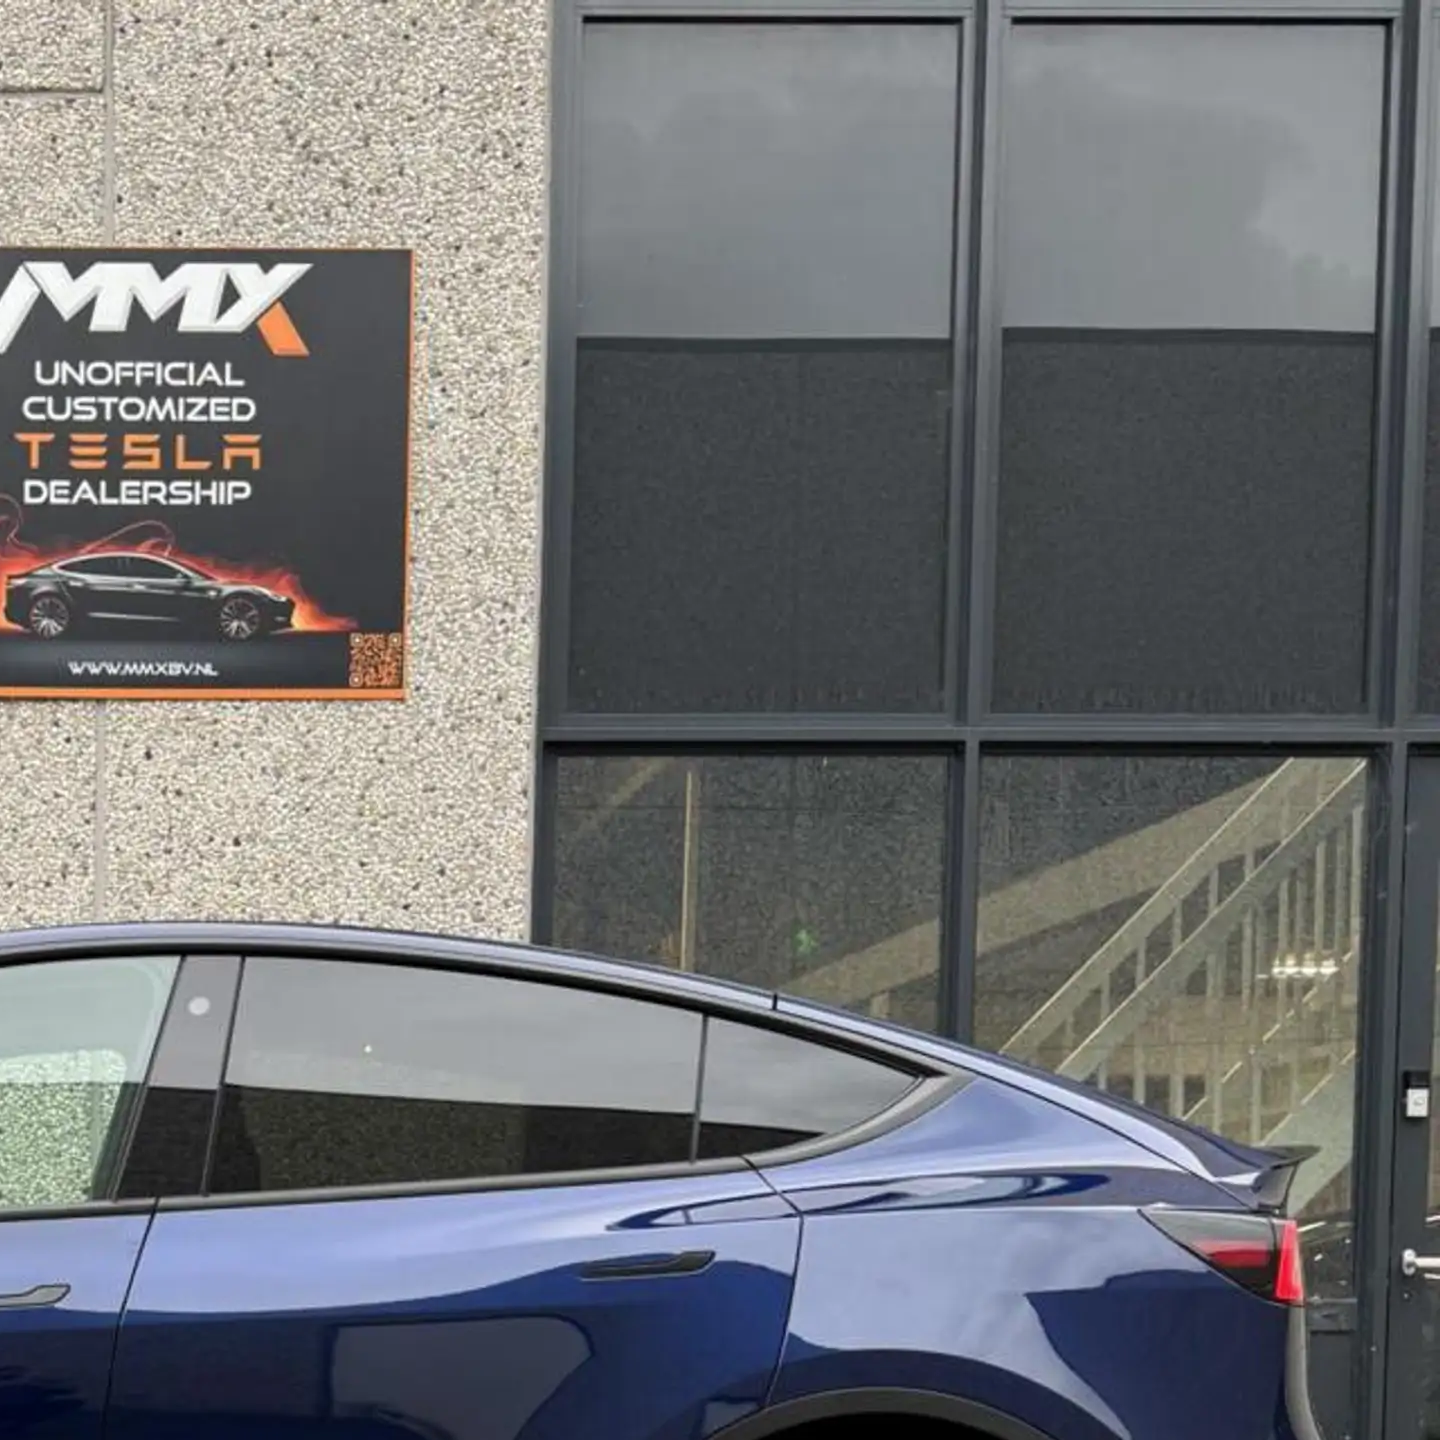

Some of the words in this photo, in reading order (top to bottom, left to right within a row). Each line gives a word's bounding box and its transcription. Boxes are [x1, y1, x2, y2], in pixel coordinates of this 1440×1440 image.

[34, 361, 245, 387] UNOFFICIAL
[22, 396, 257, 423] CUSTOMIZED
[14, 433, 262, 470] TESLA
[23, 479, 252, 506] DEALERSHIP
